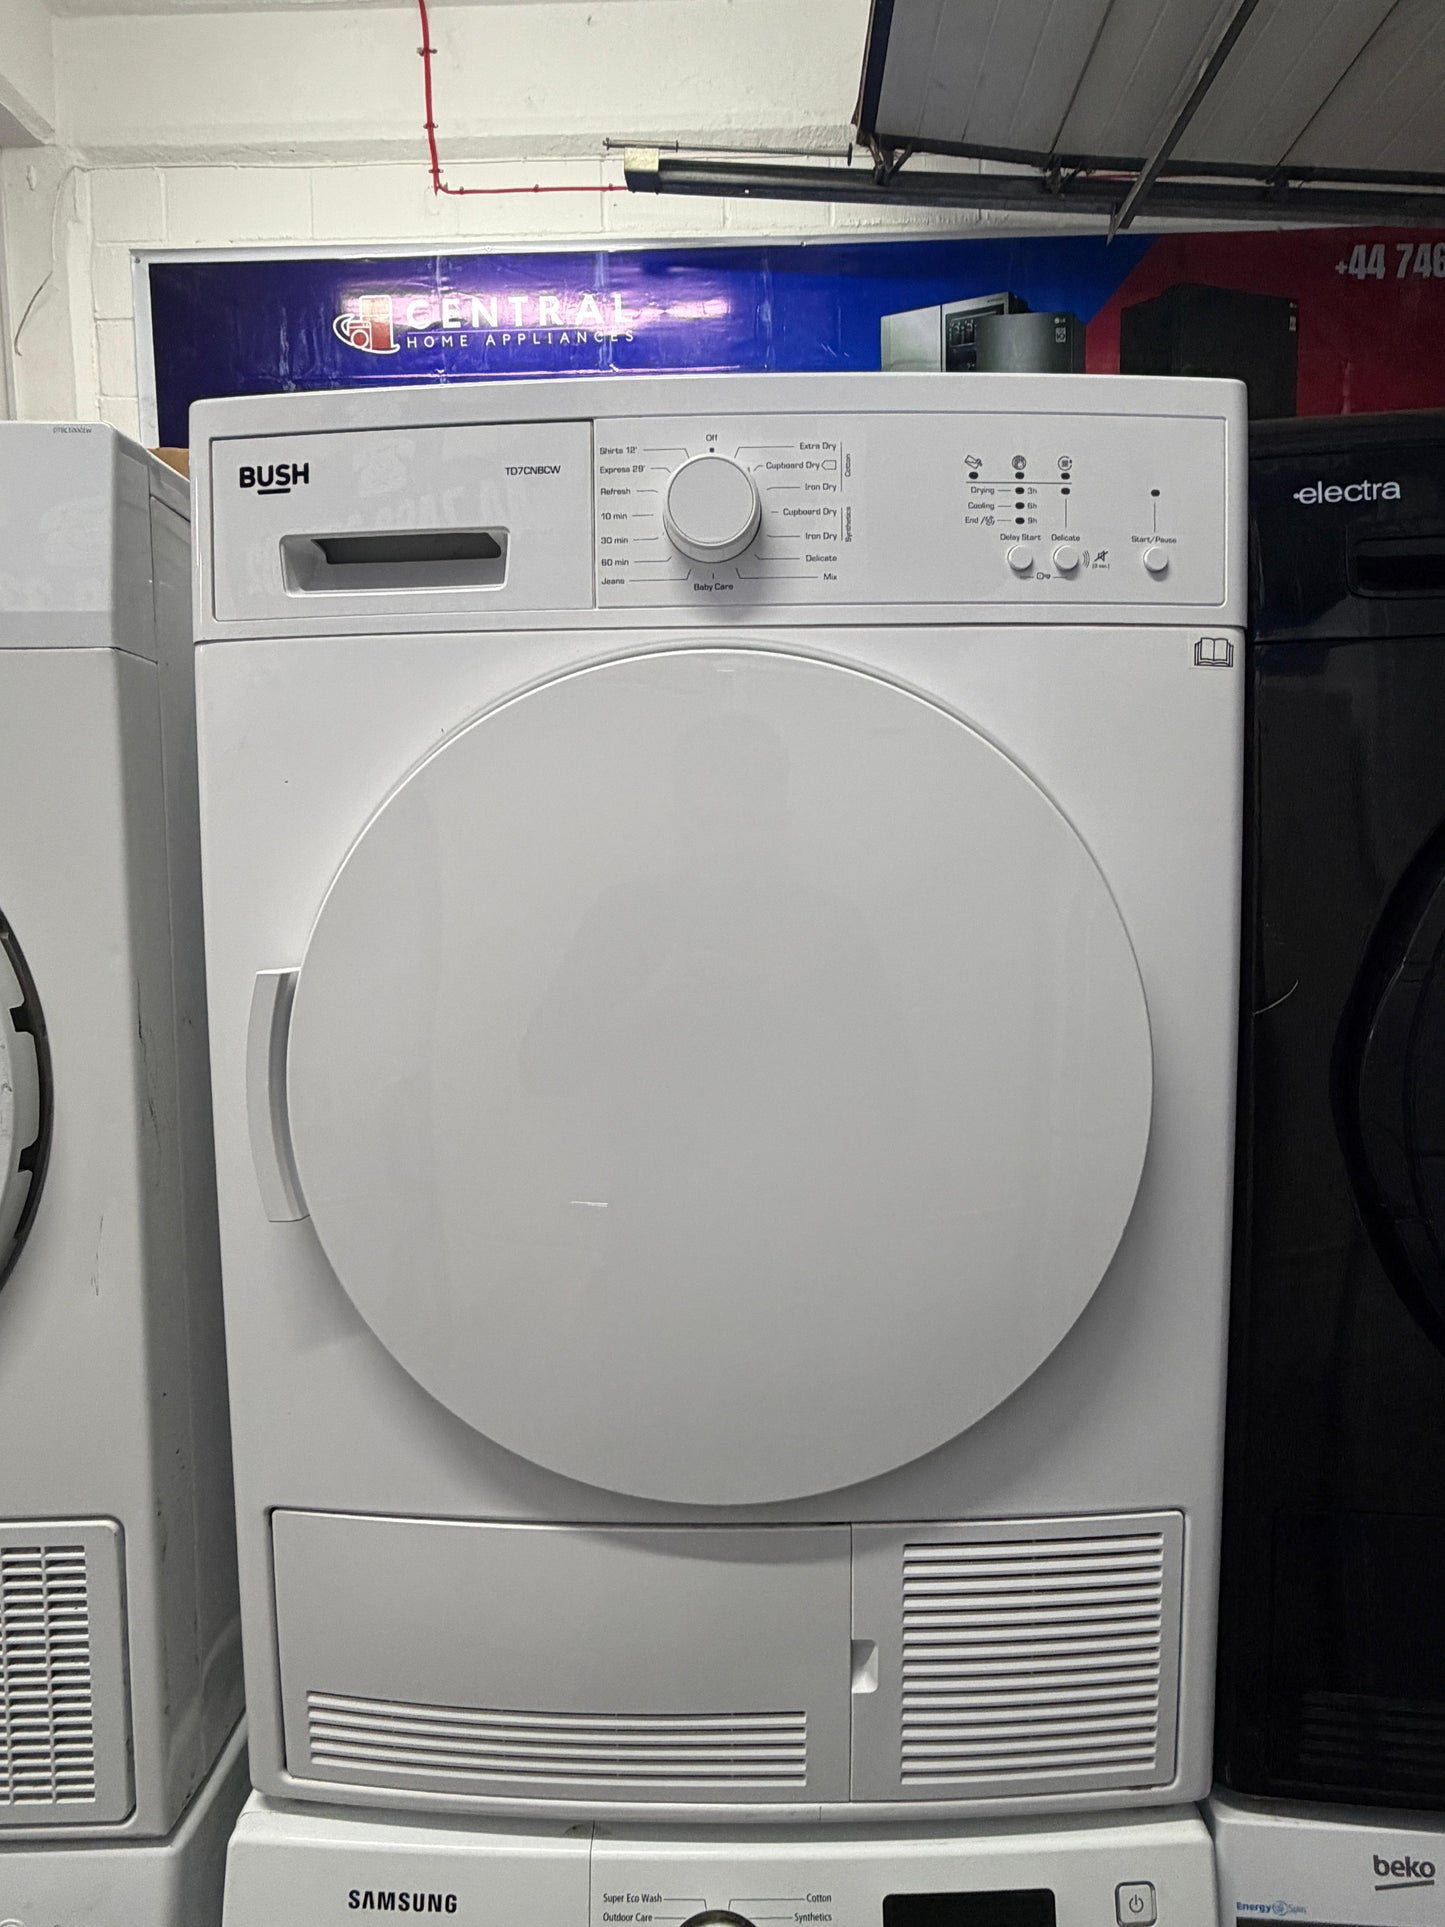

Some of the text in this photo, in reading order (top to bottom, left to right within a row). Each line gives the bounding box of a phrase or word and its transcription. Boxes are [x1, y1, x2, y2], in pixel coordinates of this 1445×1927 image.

[1335, 244, 1385, 279] +44
[407, 294, 633, 328] CENTRAL
[407, 330, 634, 348] HOME APPLIANCES
[706, 434, 717, 442] Off
[799, 442, 836, 451] Extra Dry
[600, 465, 630, 475] Express
[766, 461, 820, 471] Cupboard Dry
[239, 463, 309, 488] BUSH
[805, 483, 837, 492] Iron Dry
[971, 486, 995, 495] Drying
[1293, 480, 1400, 504] electra
[968, 502, 995, 511] Cooling
[783, 508, 837, 517] Cupboard Dry
[601, 536, 629, 544] 30 min
[823, 533, 837, 541] Dry
[1000, 534, 1020, 542] Delay
[1131, 536, 1176, 544] Start/Pause
[615, 558, 629, 566] min
[601, 577, 625, 585] Jeans
[694, 583, 733, 593] Baby Care
[1373, 1855, 1435, 1879] beko
[348, 1890, 458, 1913] SAMSUNG
[603, 1892, 662, 1905] Super Eco Wash
[806, 1892, 832, 1903] Cotton
[1236, 1902, 1271, 1913] Energy
[603, 1912, 653, 1922] Outdoor Care
[794, 1911, 832, 1924] Synthetics
